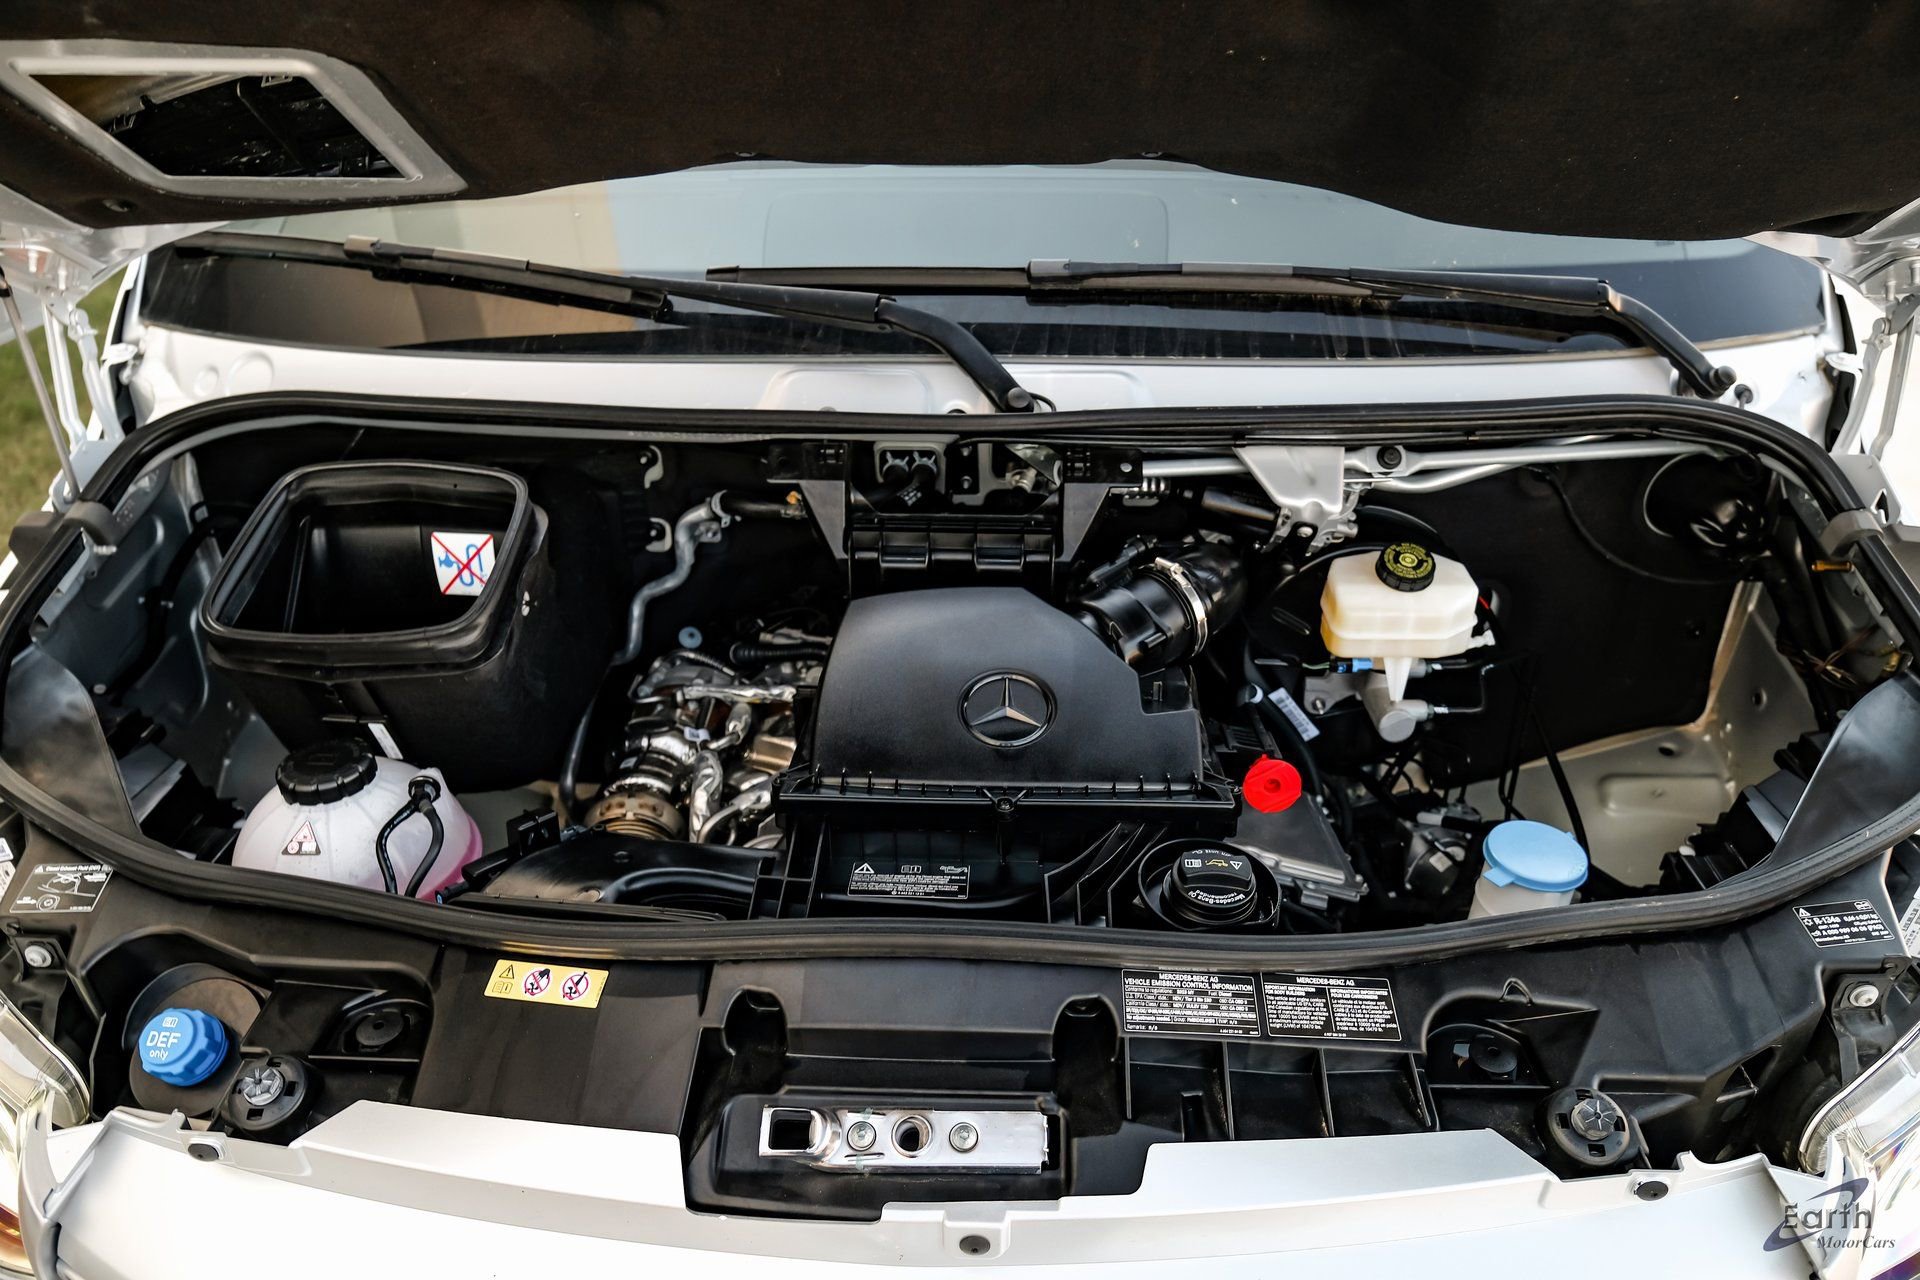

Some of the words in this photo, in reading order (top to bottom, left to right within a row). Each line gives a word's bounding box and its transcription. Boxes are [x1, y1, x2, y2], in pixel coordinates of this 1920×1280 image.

[1813, 915, 1841, 925] R-134a
[1159, 972, 1209, 983] MERCEDES-BENZ
[1296, 976, 1346, 986] MERCEDES-BENZ
[1124, 977, 1151, 986] VEHICLE
[1151, 979, 1181, 988] EMISSION
[1181, 981, 1211, 989] CONTROL
[1212, 983, 1253, 992] INFORMATION
[145, 1030, 181, 1048] DEF
[150, 1048, 168, 1060] only
